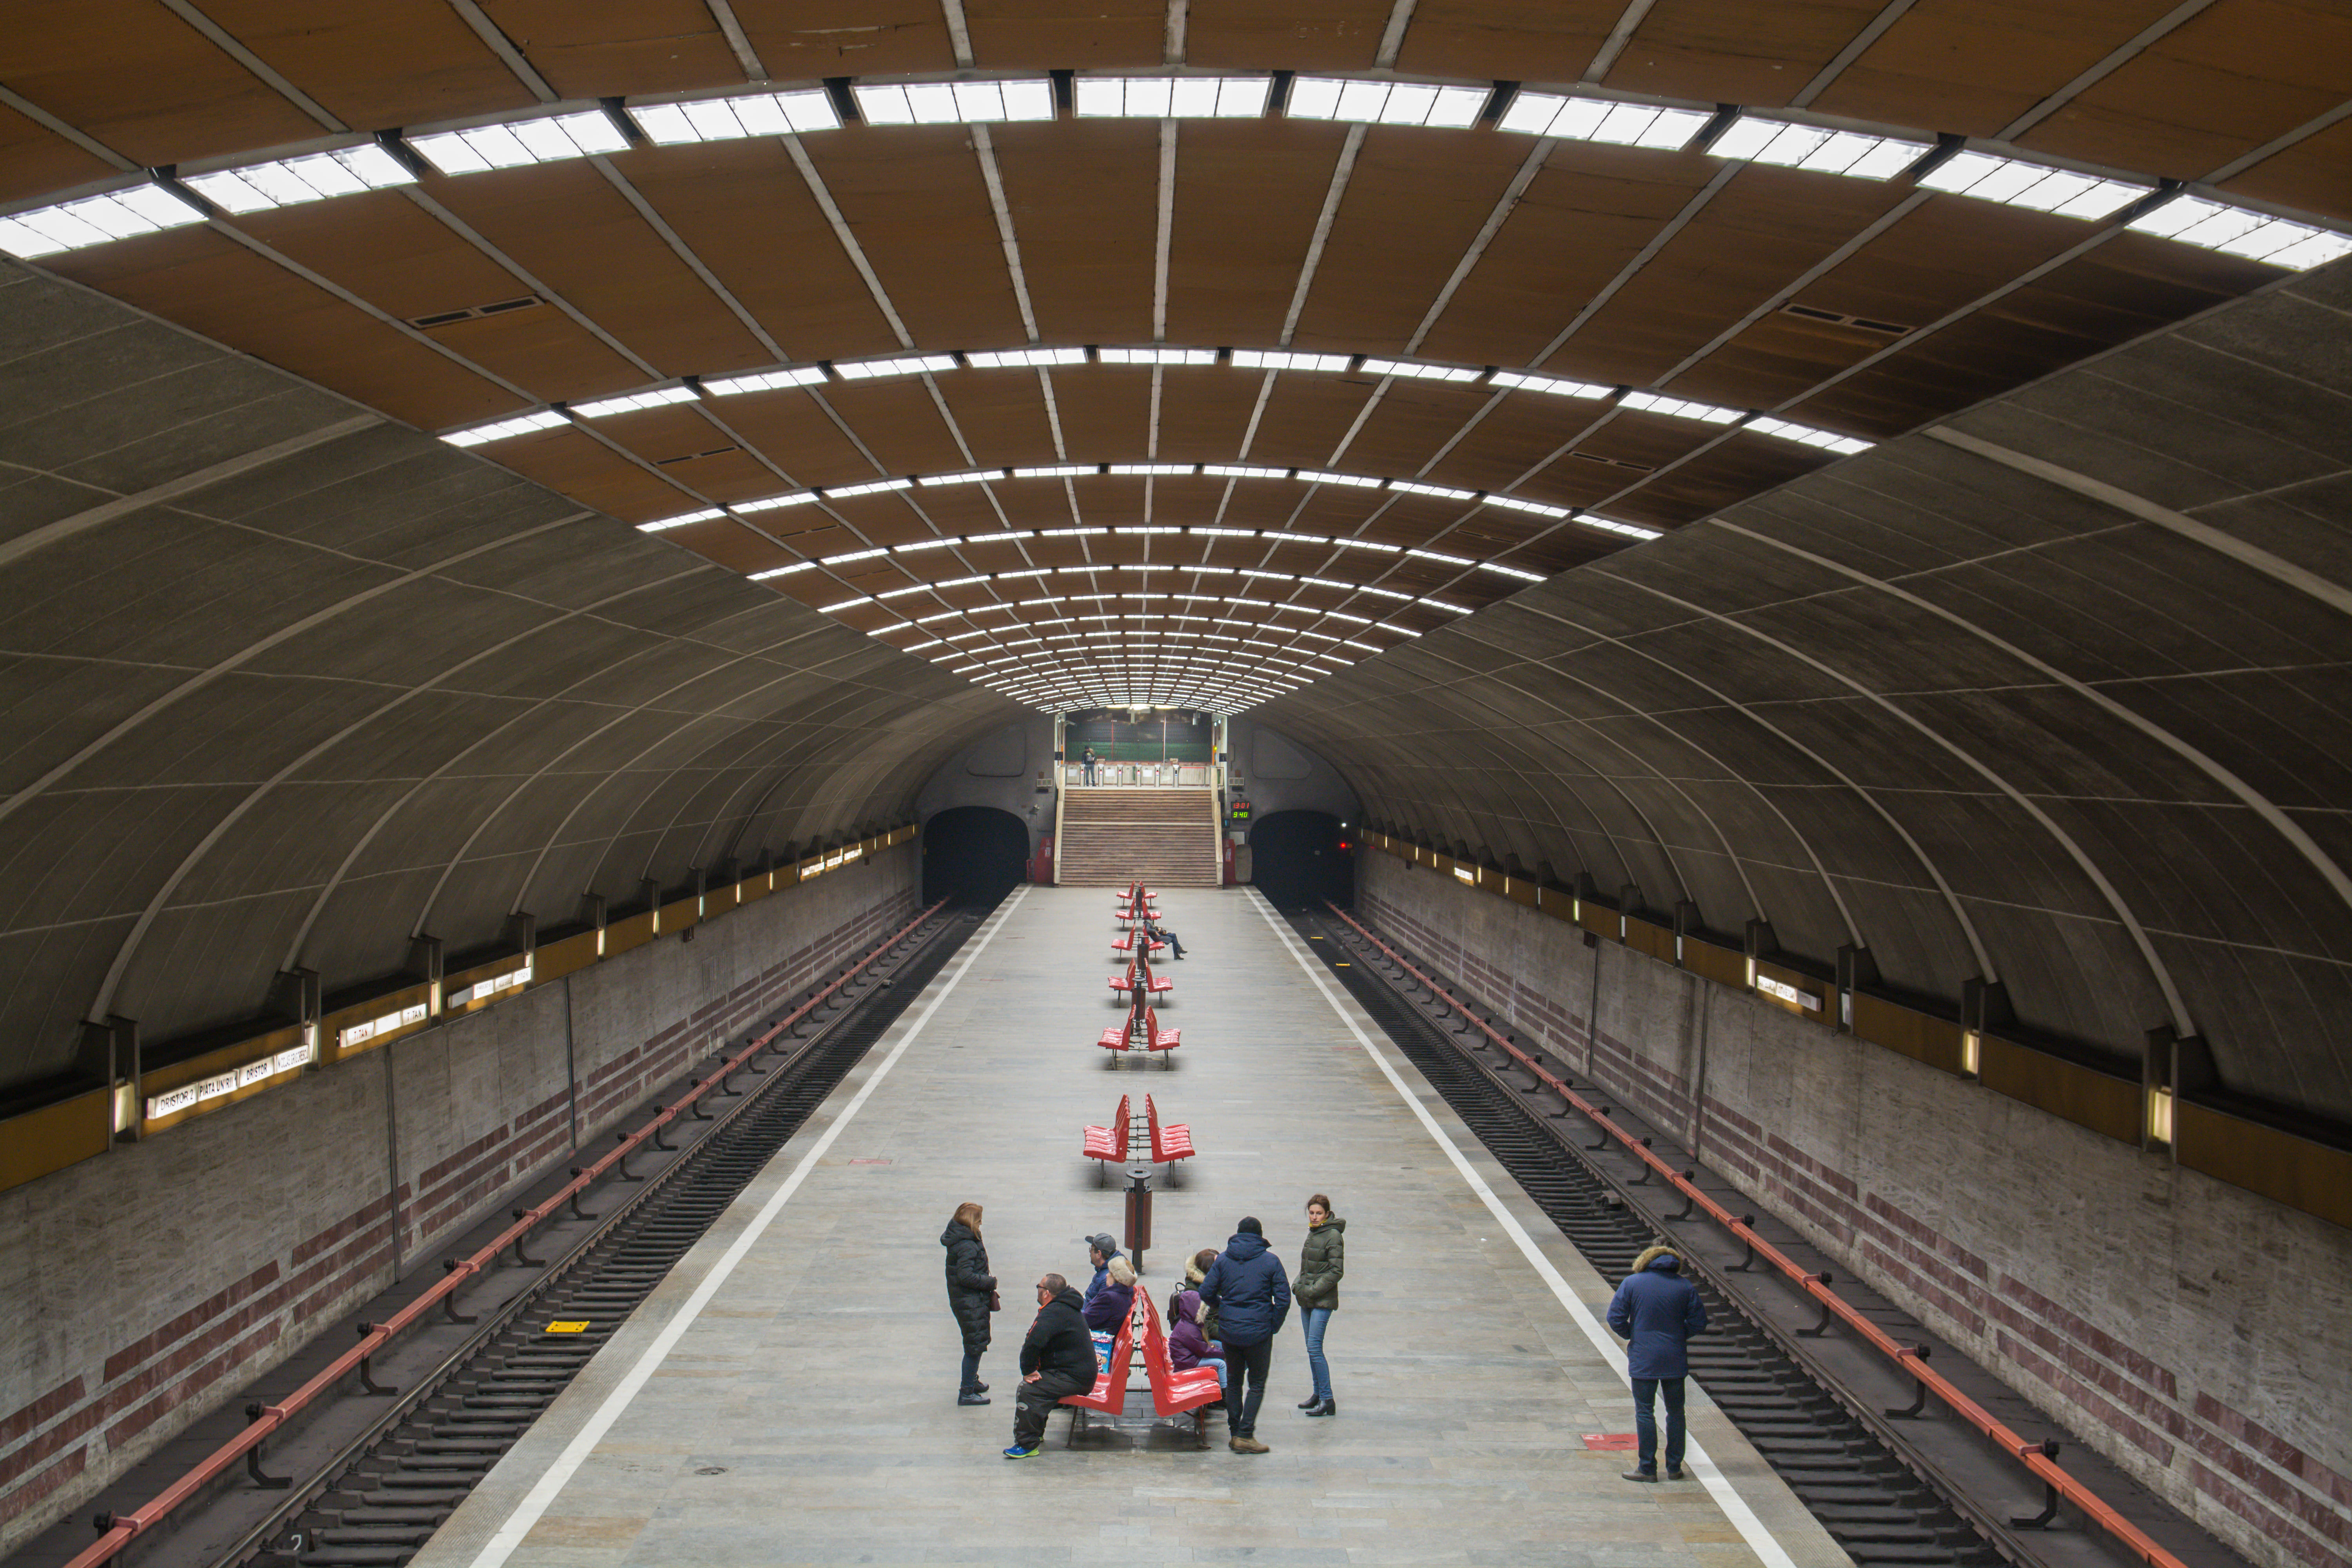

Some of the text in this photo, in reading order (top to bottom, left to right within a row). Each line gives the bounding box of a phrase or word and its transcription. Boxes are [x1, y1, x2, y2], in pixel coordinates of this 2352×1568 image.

[407, 1008, 422, 1021] TITAN
[354, 1028, 368, 1041] TITAN
[247, 1063, 267, 1080] DRISTOR
[200, 1082, 215, 1097] PIATA
[216, 1077, 233, 1093] UNIRII
[160, 1089, 194, 1111] DRISTOR 2
